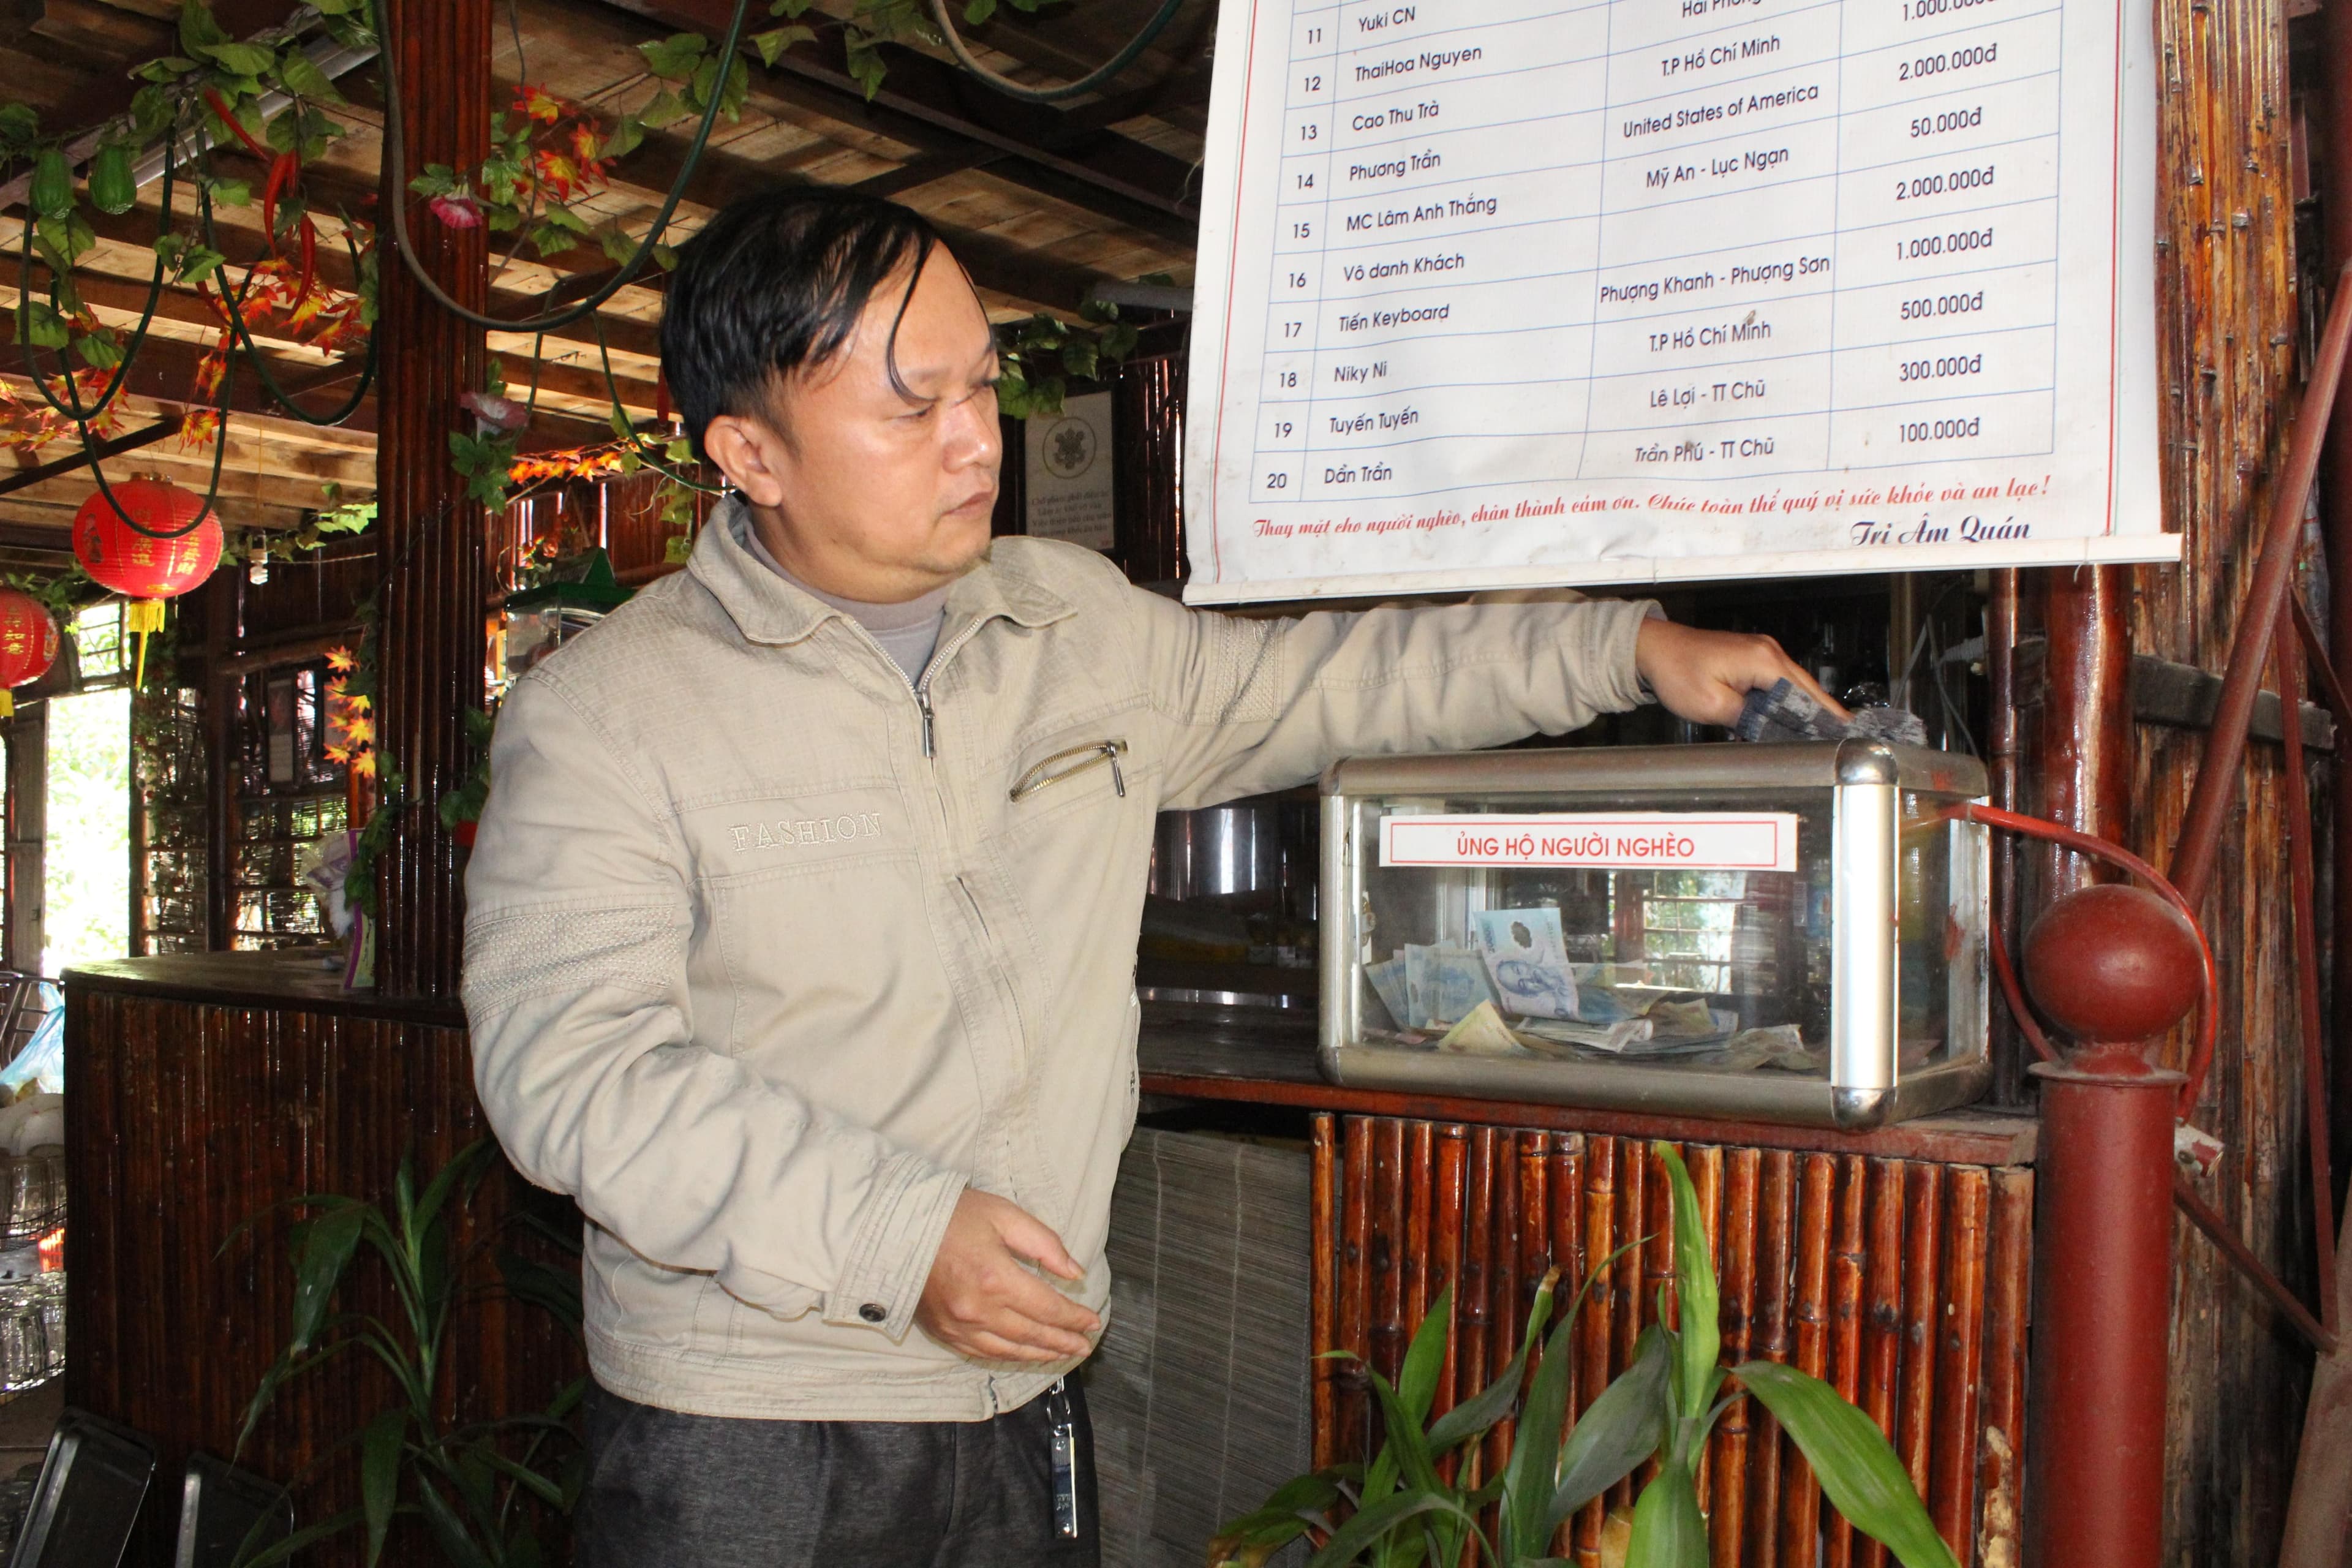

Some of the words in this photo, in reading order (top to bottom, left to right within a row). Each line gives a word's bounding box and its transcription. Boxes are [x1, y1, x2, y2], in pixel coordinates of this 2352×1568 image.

[1359, 12, 1389, 32] Yuki
[1392, 6, 1415, 25] CN
[1308, 28, 1322, 45] 11
[1355, 58, 1415, 82] ThaiHoa
[1419, 47, 1482, 71] Nguyen
[1661, 57, 1680, 77] T.P
[1709, 42, 1738, 66] Chí
[1741, 34, 1781, 59] Minh
[1899, 42, 1998, 81] 2.000.000đ
[1305, 75, 1321, 92] 12
[1352, 114, 1384, 132] Cao
[1388, 108, 1414, 125] Thu
[1417, 99, 1439, 119] Trà
[1623, 112, 1672, 138] United
[1676, 105, 1723, 128] States
[1727, 97, 1744, 117] of
[1746, 85, 1819, 113] America
[1910, 105, 1983, 138] 50.000đ
[1301, 124, 1317, 141] 13
[1349, 160, 1406, 181] Phương
[1410, 148, 1441, 171] Trần
[1646, 166, 1670, 189] Mỹ
[1673, 165, 1695, 183] An
[1711, 157, 1739, 178] Lục
[1744, 148, 1789, 172] Ngạn
[1297, 173, 1314, 190] 14
[1896, 165, 1995, 201] 2.000.000đ
[1346, 213, 1373, 232] MC
[1377, 209, 1409, 228] Lâm
[1412, 203, 1444, 222] Anh
[1448, 192, 1498, 217] Thắng
[1293, 222, 1310, 239] 15
[1897, 227, 1994, 260] 1.000.000đ
[1289, 272, 1306, 288] 16
[1343, 264, 1365, 282] Vô
[1369, 260, 1409, 279] danh
[1413, 252, 1464, 274] Khách
[1600, 282, 1659, 303] Phượng
[1664, 271, 1714, 295] Khanh
[1731, 262, 1794, 285] Phượng
[1798, 256, 1830, 275] Sơn
[1339, 312, 1368, 332] Tiến
[1372, 303, 1450, 328] Keyboard
[1901, 290, 1984, 320] 500.000đ
[1284, 322, 1302, 338] 17
[1649, 333, 1668, 352] T.P
[1699, 323, 1727, 346] Chí
[1732, 321, 1771, 342] Minh
[1280, 372, 1297, 388] 18
[1334, 366, 1369, 384] Niky
[1373, 361, 1387, 379] Ni
[1899, 353, 1983, 382] 300.000đ
[1650, 389, 1668, 408] Lê
[1673, 386, 1695, 409] Lợi
[1275, 421, 1292, 439] 19
[1329, 413, 1374, 436] Tuyến
[1378, 405, 1419, 431] Tuyến
[1899, 416, 1981, 443] 100.000đ
[1635, 443, 1668, 462] Trần
[1673, 440, 1703, 462] Phú
[1266, 473, 1287, 489] 20
[1360, 461, 1392, 482] Trần
[1254, 519, 1294, 538] Thay
[1298, 519, 1331, 538] mặt
[1334, 517, 1362, 533] cho
[1471, 504, 1509, 522] chân
[1514, 496, 1565, 519] thành
[1648, 494, 1696, 512] Chúc
[1700, 499, 1743, 514] toàn
[1782, 490, 1819, 514] quý
[1824, 489, 1845, 511] vị
[1940, 482, 1966, 502] và
[1972, 486, 1999, 500] an
[2006, 475, 2051, 502] lạc!
[1851, 521, 1893, 546] Tri
[1897, 512, 1950, 545] Âm
[1960, 516, 2030, 544] Quán
[729, 813, 881, 851] FASHION
[1457, 831, 1499, 856] ỦNG
[1506, 833, 1535, 859] HỘ
[1541, 832, 1609, 857] NGƯỜI
[1616, 832, 1695, 858] NGHÈO
